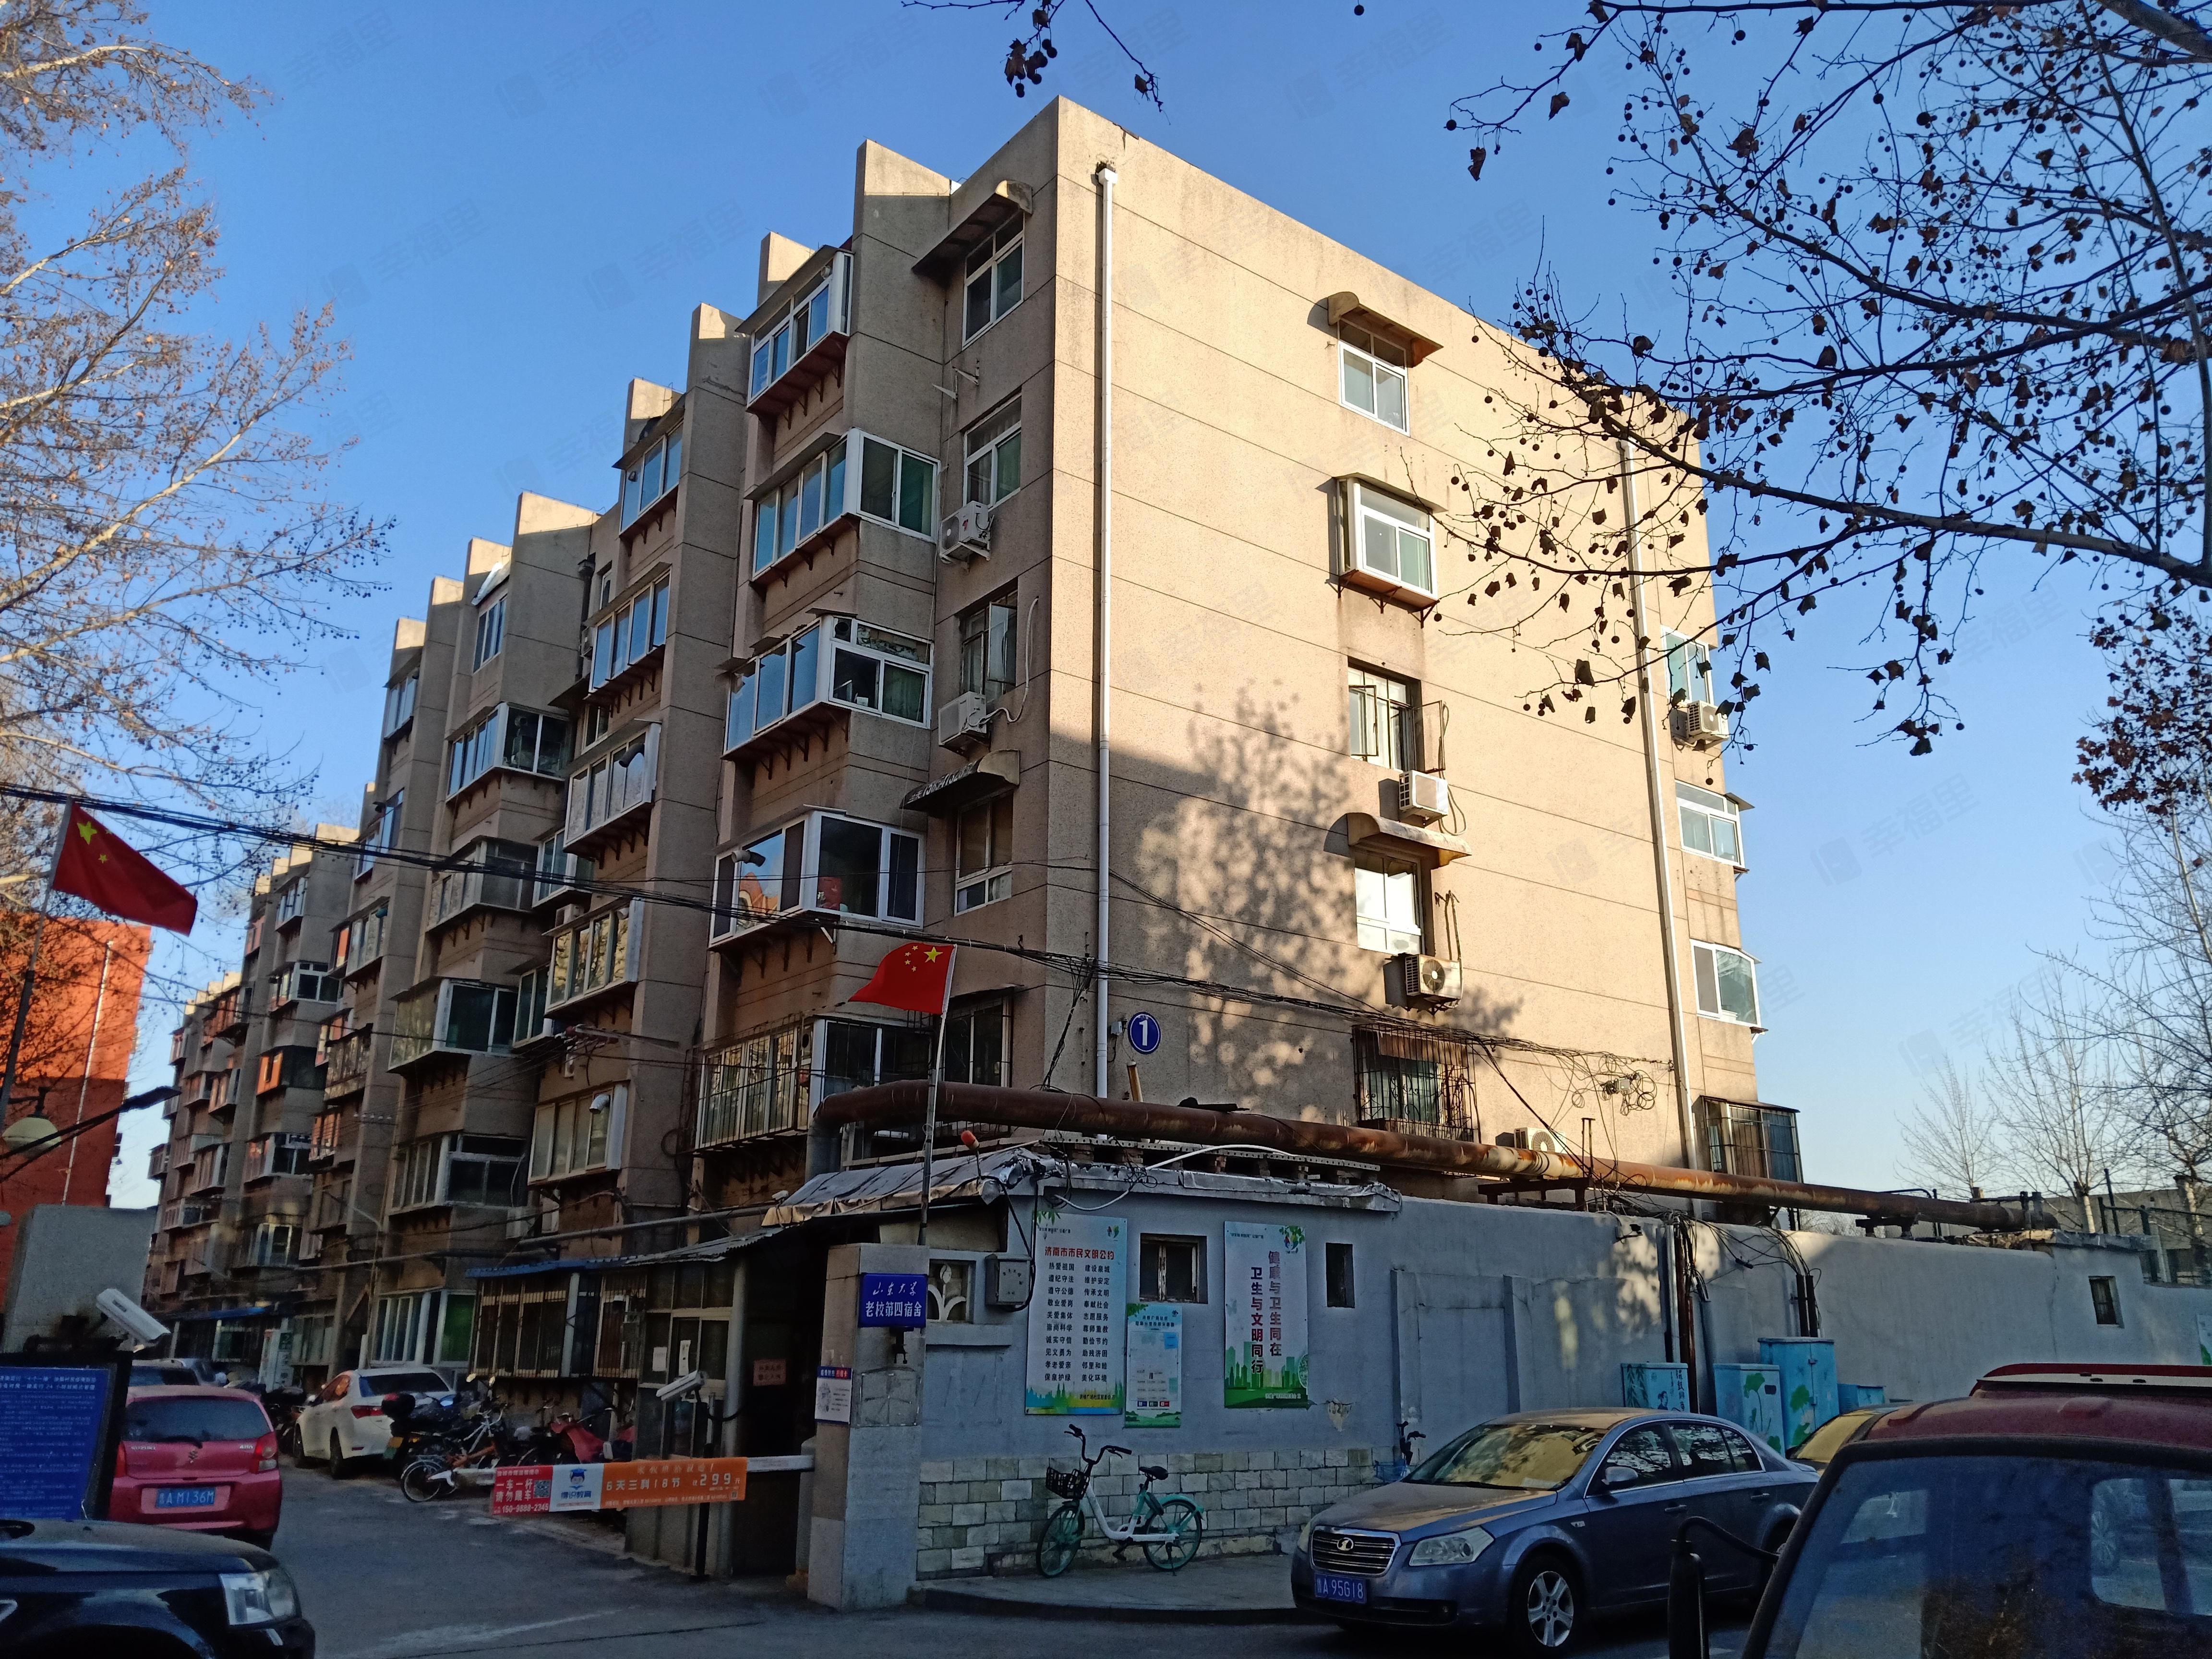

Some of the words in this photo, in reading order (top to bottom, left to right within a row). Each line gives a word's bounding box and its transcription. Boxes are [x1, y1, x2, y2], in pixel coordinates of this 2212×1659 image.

[1139, 1020, 1148, 1046] 1
[1045, 1246, 1115, 1260] 济南市市民文明公约
[1049, 1262, 1075, 1271] 热爱祖国
[1085, 1264, 1110, 1273] 建设泉城
[1048, 1274, 1074, 1283] 遵纪守法
[1084, 1276, 1110, 1285] 维护安定
[872, 1281, 917, 1297] 山东大学
[1048, 1286, 1074, 1295] 遵守公德
[1084, 1289, 1109, 1297] 传承文明
[865, 1300, 922, 1317] 老校第四宿舍
[1047, 1298, 1073, 1308] 敬业爱岗
[1084, 1300, 1109, 1309] 奉献社会
[1268, 1250, 1282, 1357] 健康与卫生同在
[1083, 1313, 1108, 1321] 志愿服务
[1250, 1267, 1263, 1373] 卫生与文明同行
[1046, 1323, 1072, 1332] 崇尚科学
[1083, 1325, 1108, 1333] 尊师重教
[1046, 1336, 1072, 1344] 诚实守信
[1082, 1337, 1108, 1346] 勤俭节约
[1046, 1348, 1071, 1357] 见义勇为
[1082, 1349, 1107, 1358] 助残济困
[1045, 1361, 1071, 1369] 孝老爱亲
[1082, 1362, 1107, 1370] 邻里和睦
[1045, 1373, 1071, 1382] 保泉护绿
[496, 1479, 533, 1490] 一车一杆
[495, 1490, 532, 1502] 请勿跟车
[502, 1503, 549, 1514] 150-9888-2345
